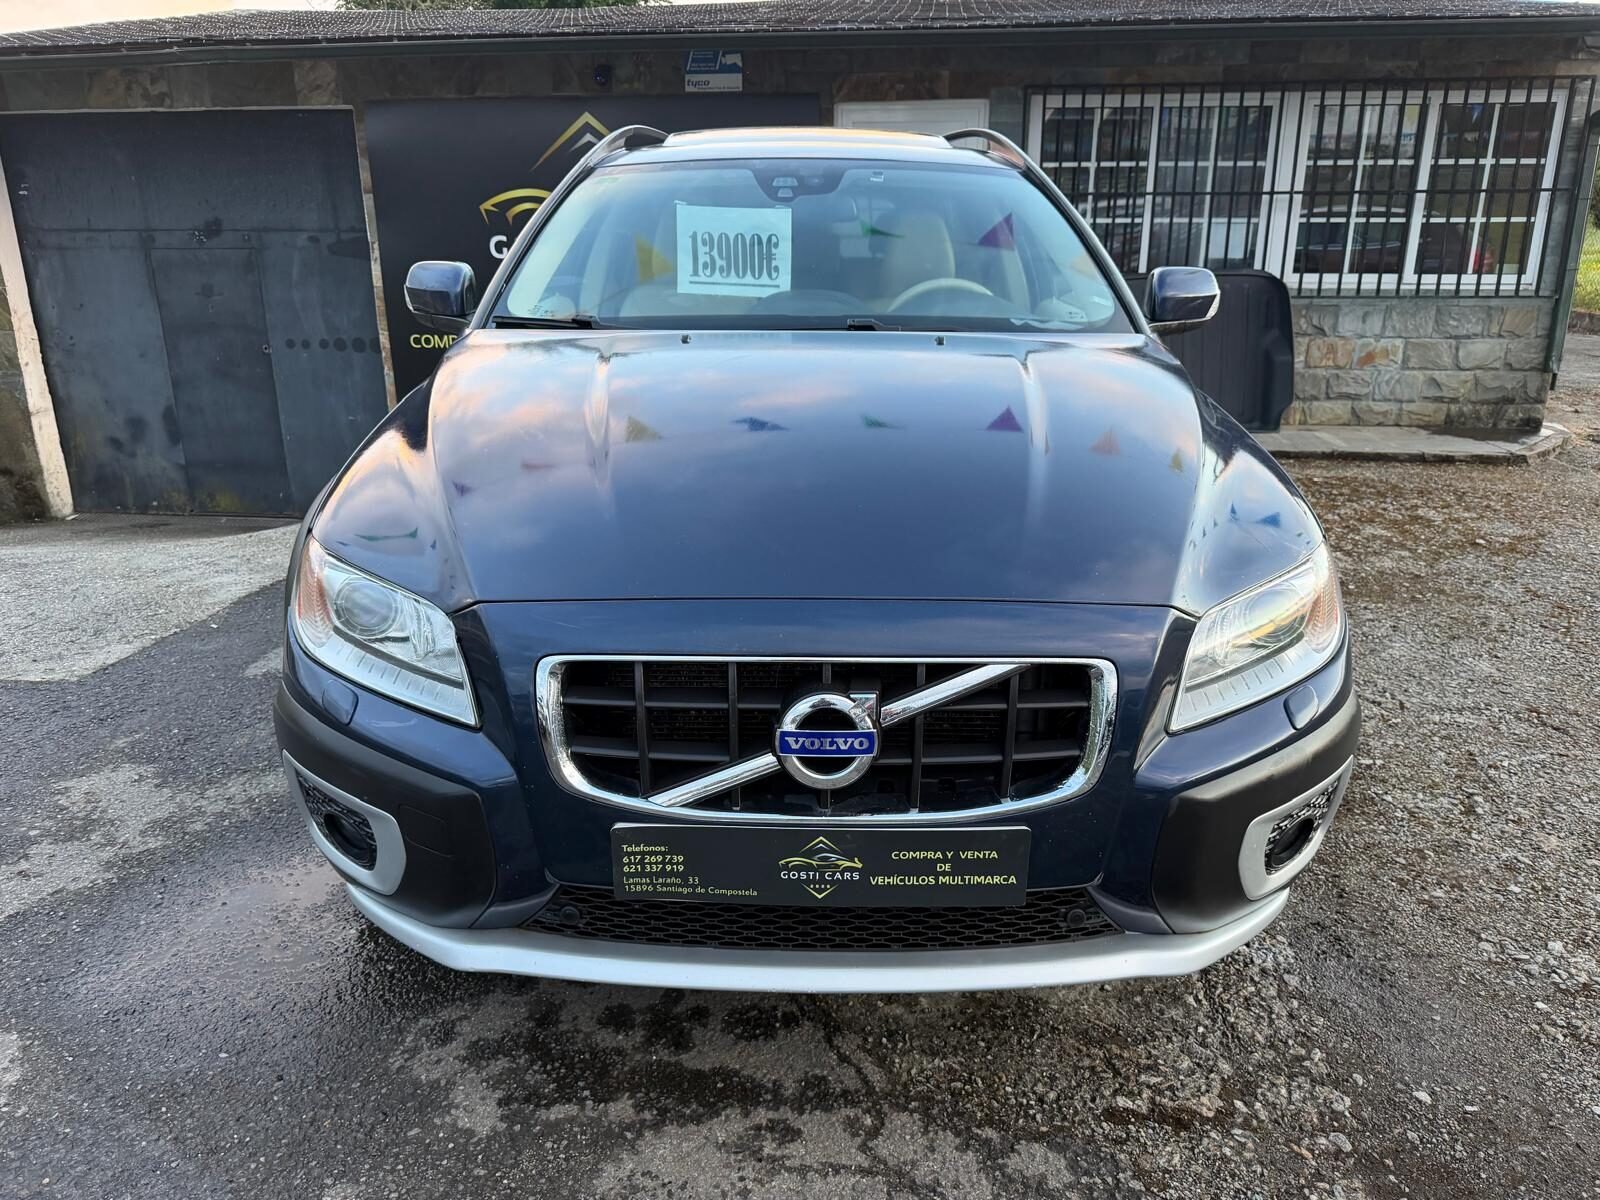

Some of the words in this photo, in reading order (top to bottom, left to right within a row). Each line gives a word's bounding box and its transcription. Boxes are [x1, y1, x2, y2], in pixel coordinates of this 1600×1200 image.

[687, 79, 710, 88] tyco
[688, 230, 780, 281] 13900€
[785, 737, 869, 750] VOLVO
[622, 844, 669, 852] Telefonos:
[623, 855, 641, 863] 617
[644, 855, 663, 863] 269
[665, 855, 684, 863] 739
[891, 851, 943, 859] COMPRA
[946, 851, 954, 859] Y
[959, 851, 998, 859] VENTA
[623, 865, 641, 873] 621
[645, 865, 663, 873] 337
[666, 865, 684, 873] 919
[936, 863, 952, 872] DE
[623, 876, 651, 884] Lamas
[688, 876, 699, 884] 33
[780, 871, 819, 880] GOSTI
[825, 872, 860, 880] CARS
[870, 874, 935, 885] VEHÍCULOS
[938, 875, 1017, 885] MULTIMARCA
[625, 884, 654, 892] 15896
[656, 884, 693, 894] Santiago
[695, 885, 706, 893] de
[708, 886, 758, 896] Compostela
